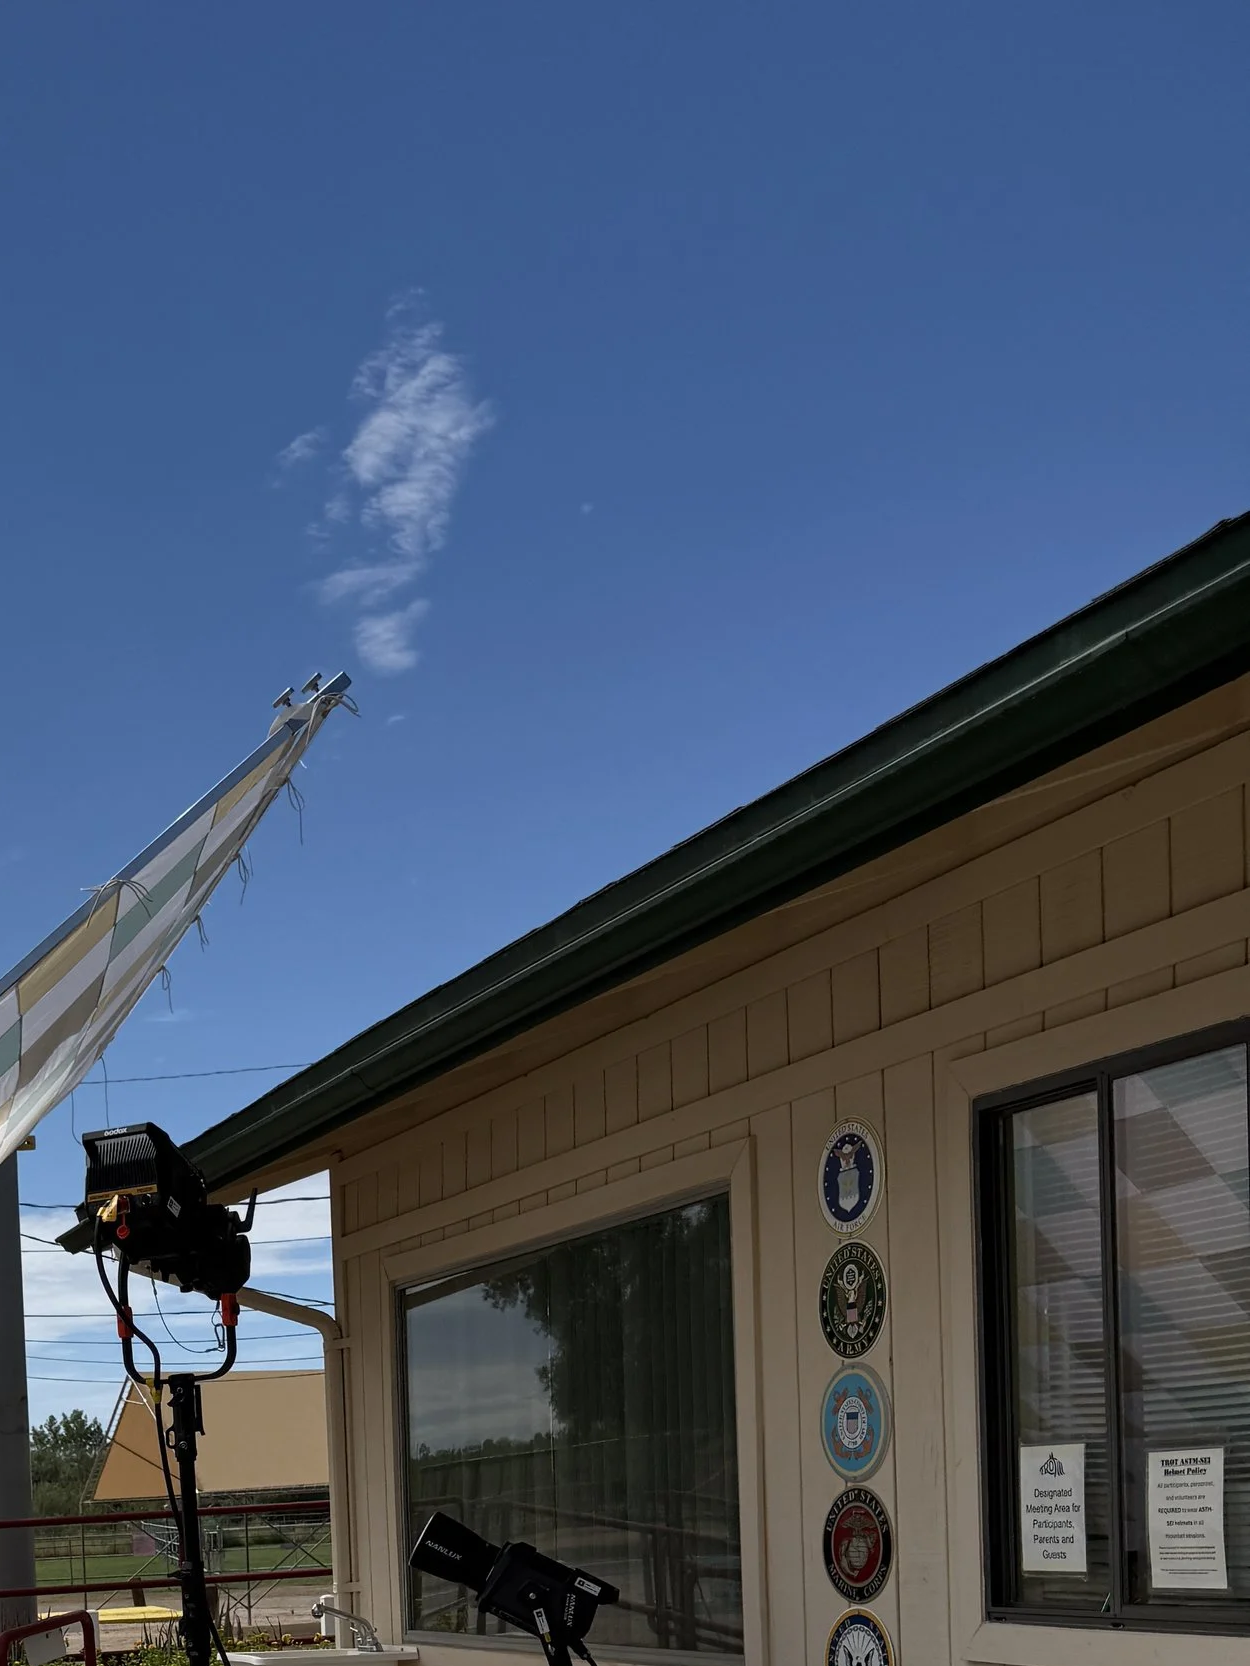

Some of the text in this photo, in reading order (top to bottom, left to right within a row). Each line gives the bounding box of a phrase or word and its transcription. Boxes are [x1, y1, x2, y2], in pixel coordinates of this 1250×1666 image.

[826, 1124, 868, 1151] UNITED STATES
[834, 1215, 867, 1231] AIR FORCE
[823, 1247, 880, 1289] UNITED STATES
[838, 1339, 868, 1354] ARMY
[1181, 1457, 1211, 1465] ASTM-SEI
[1164, 1467, 1207, 1476] Helmet Policy
[1034, 1488, 1072, 1499] Designated
[827, 1491, 888, 1533] UNITED STATES
[1026, 1503, 1080, 1515] Meeting Area for
[1033, 1519, 1075, 1530] Participants,
[1033, 1534, 1074, 1543] Parents and
[425, 1540, 463, 1560] NANLUX
[1042, 1549, 1067, 1559] Guests
[828, 1564, 887, 1598] MARINE CORPS
